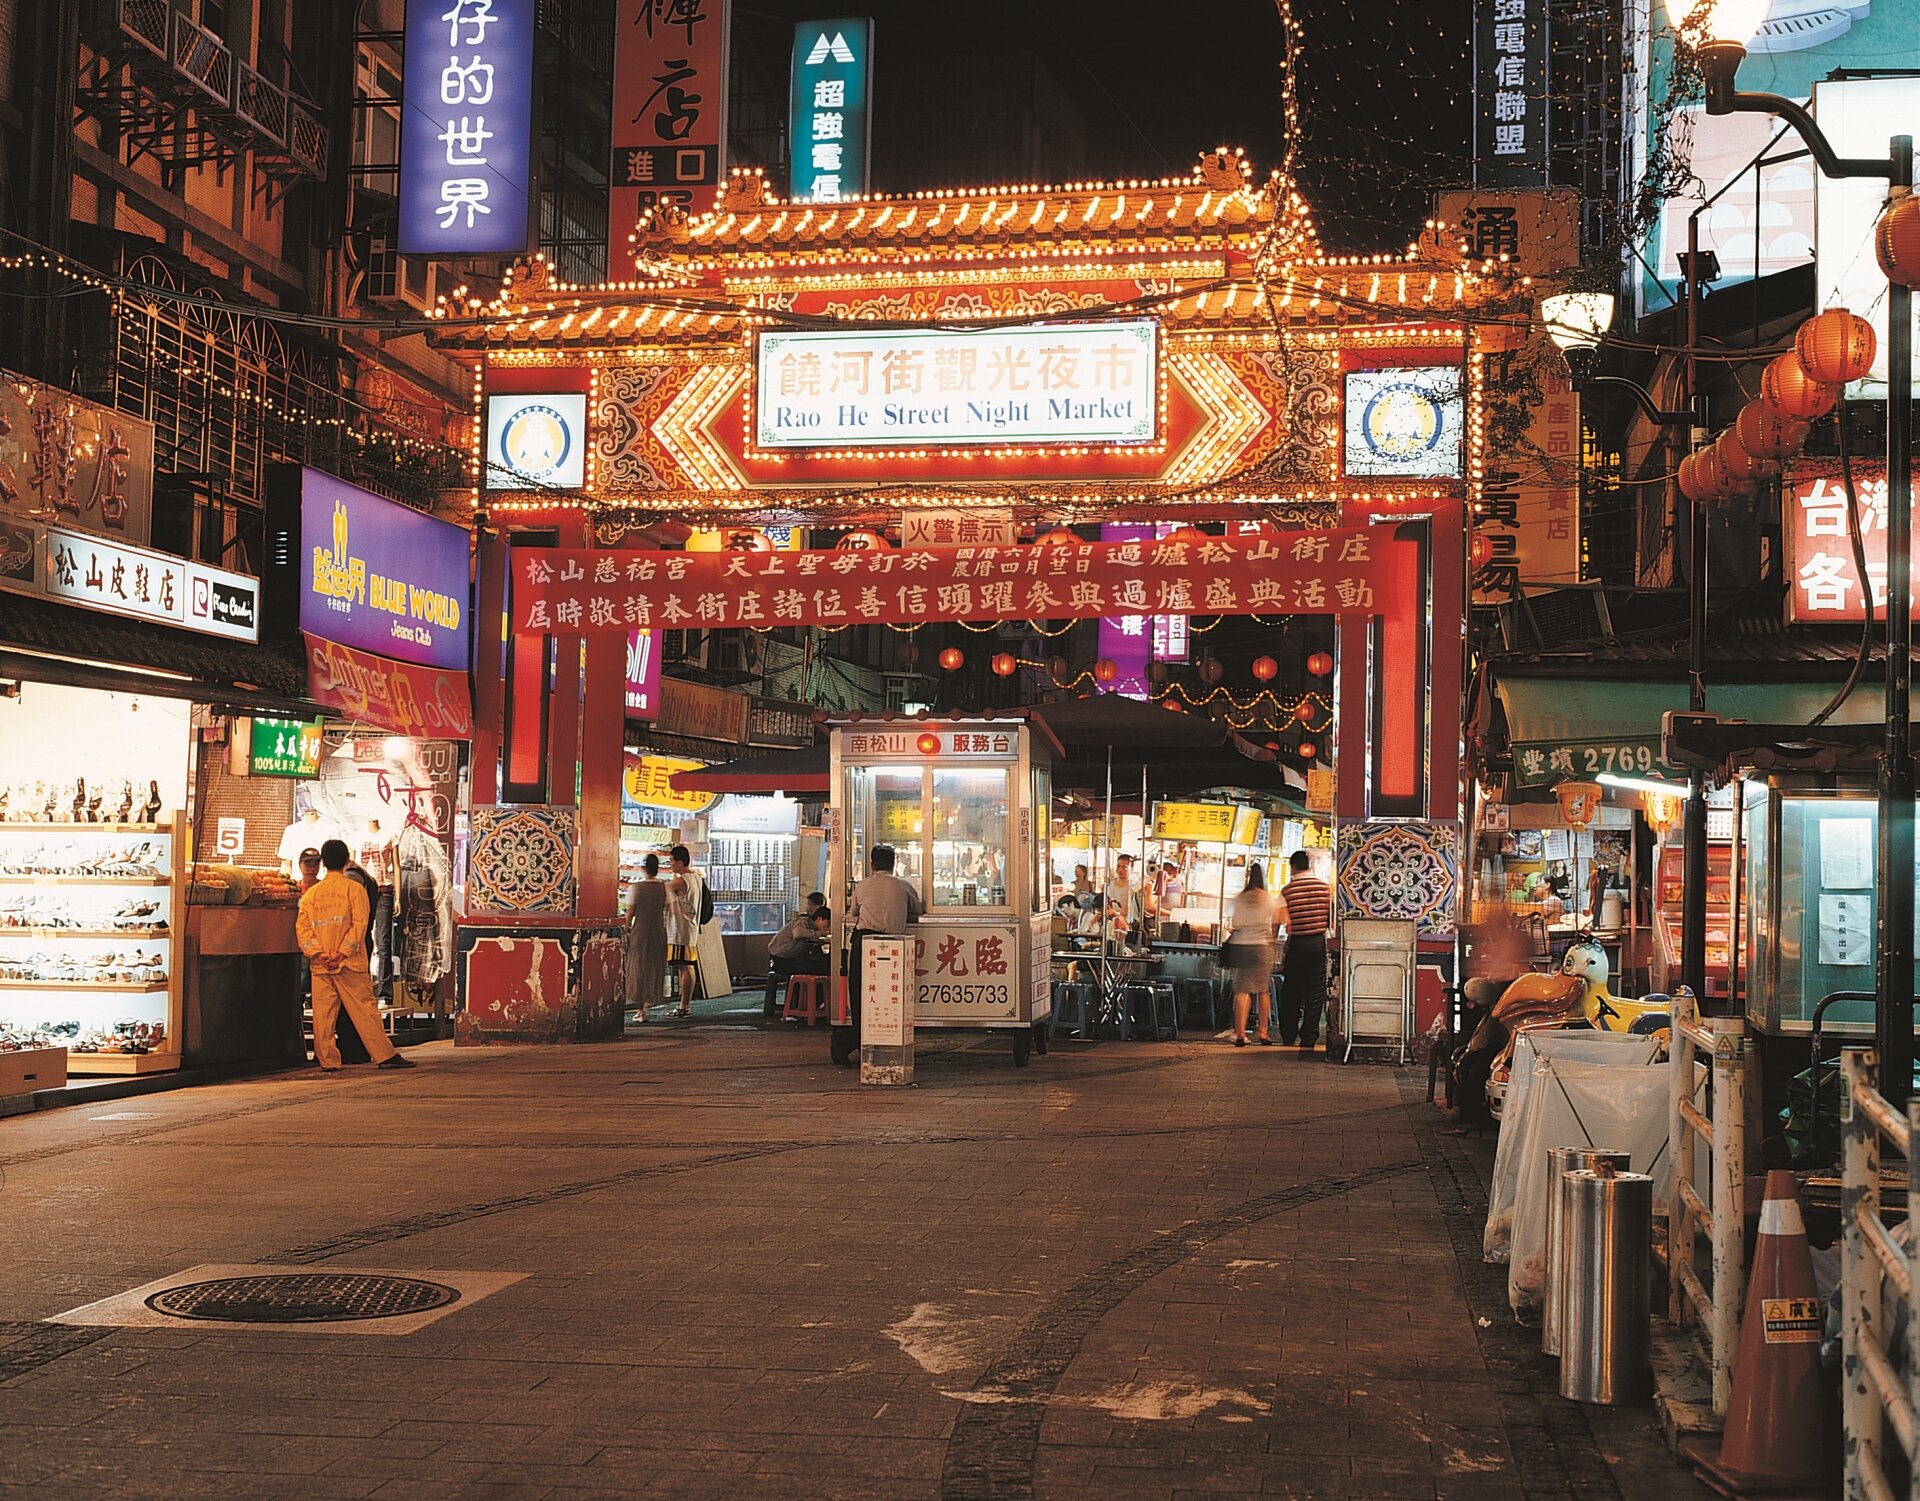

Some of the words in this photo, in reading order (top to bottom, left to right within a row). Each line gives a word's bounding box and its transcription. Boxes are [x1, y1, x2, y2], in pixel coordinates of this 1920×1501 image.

[435, 0, 498, 229] 仔的世界
[811, 80, 844, 202] 超強電信
[627, 150, 705, 182] 進口
[779, 345, 1137, 397] 饒河街觀光夜市
[775, 406, 821, 428] Rao
[838, 405, 869, 426] He
[884, 402, 950, 425] Street
[965, 397, 1030, 428] Night
[1048, 397, 1133, 420] Market
[0, 403, 131, 530] 鞋店
[908, 518, 1002, 543] 火警標示
[54, 543, 175, 611] 松山皮鞋店
[313, 546, 366, 605] 藍世界
[526, 557, 694, 586] 松山慈祐宮
[722, 552, 939, 578] 天上聖母訂於
[1106, 534, 1372, 567] 過爐松山街庄
[370, 574, 407, 616] BLUE
[409, 584, 460, 630] WORLD
[391, 620, 414, 642] Jeans
[415, 626, 431, 646] Club
[355, 744, 384, 759] Lee
[850, 735, 905, 753] 南松山
[953, 734, 1010, 752] 服務台
[221, 830, 239, 850] 5
[1020, 809, 1029, 845] 小心扒手
[919, 985, 1009, 1004] 27635733
